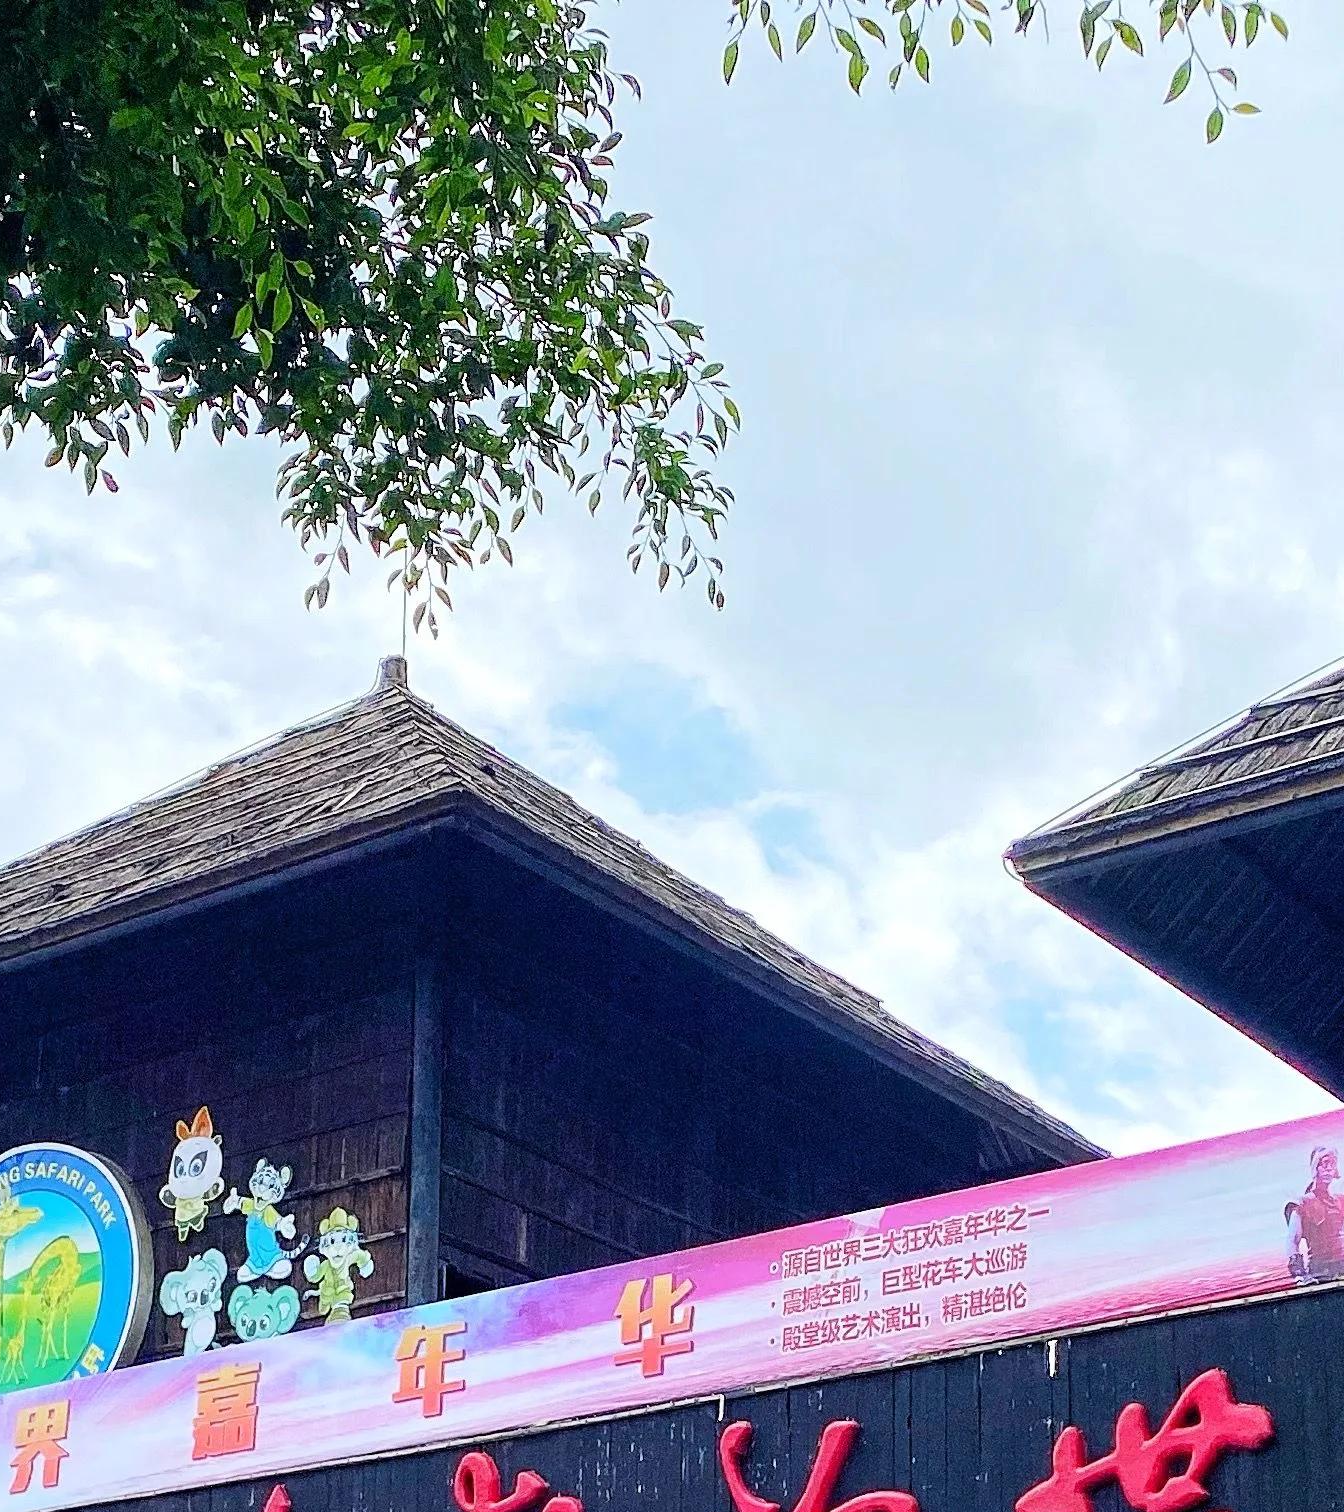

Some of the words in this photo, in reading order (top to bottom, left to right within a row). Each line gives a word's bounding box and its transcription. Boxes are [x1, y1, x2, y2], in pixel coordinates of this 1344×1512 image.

[25, 1162, 86, 1191] SAFARI
[83, 1181, 117, 1231] PARK
[783, 1205, 1050, 1278] 源自世界三大狂欢嘉年华之一
